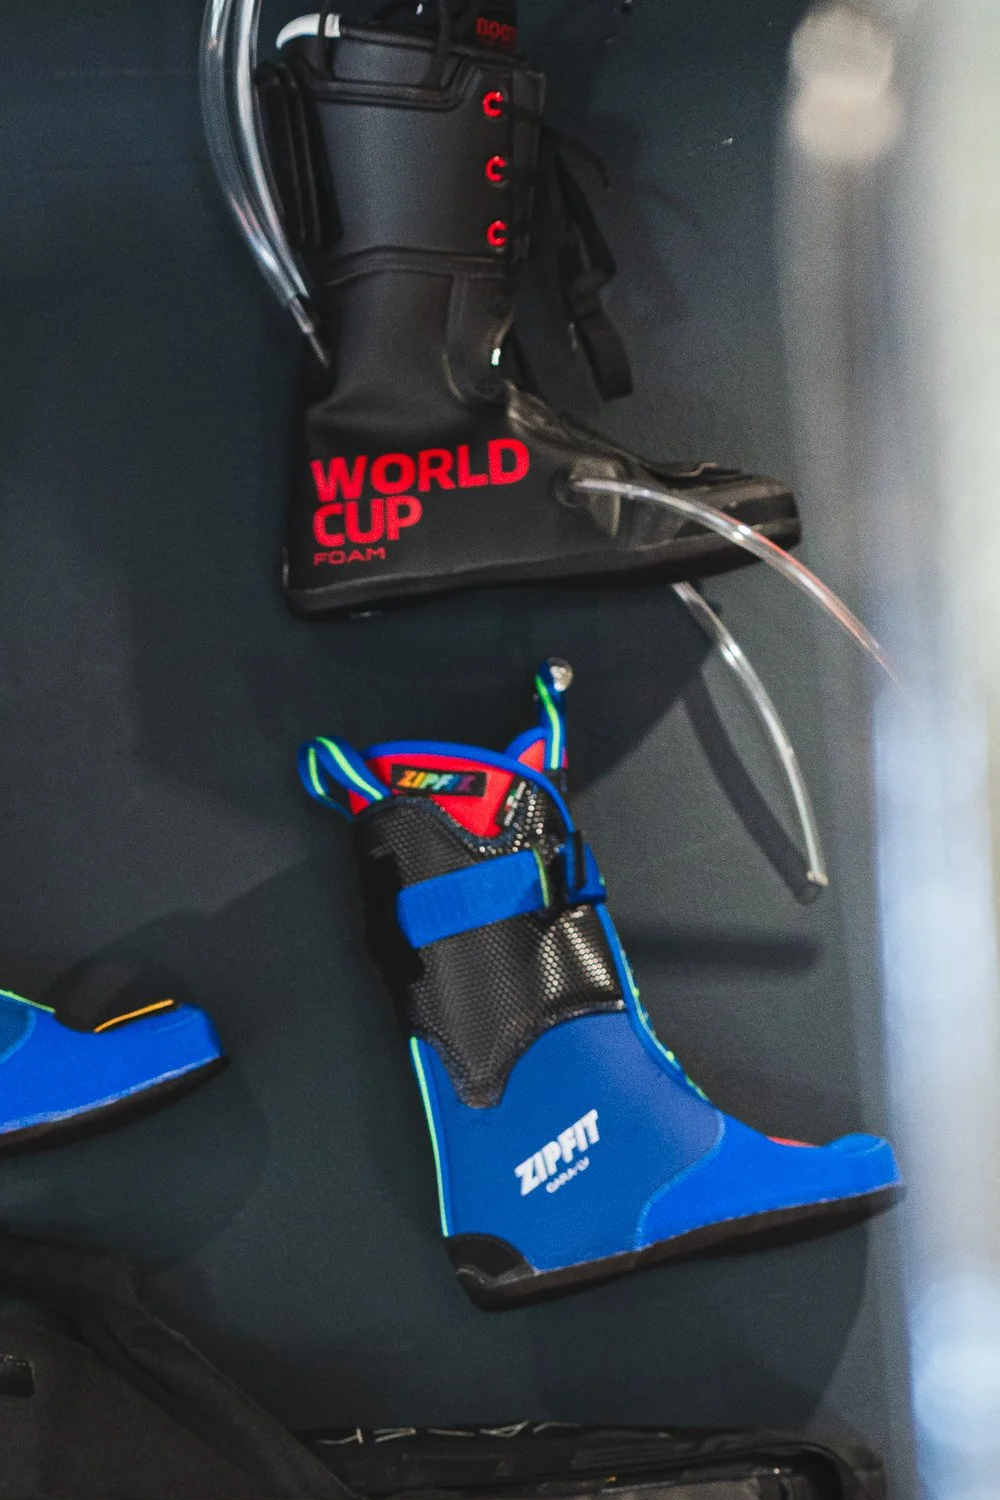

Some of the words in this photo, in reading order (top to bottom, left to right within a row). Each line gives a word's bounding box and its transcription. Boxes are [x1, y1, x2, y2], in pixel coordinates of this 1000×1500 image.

[310, 438, 530, 502] WORLD
[313, 495, 423, 547] CUP
[313, 546, 386, 566] FOAM
[514, 1108, 600, 1197] ZIPFIT
